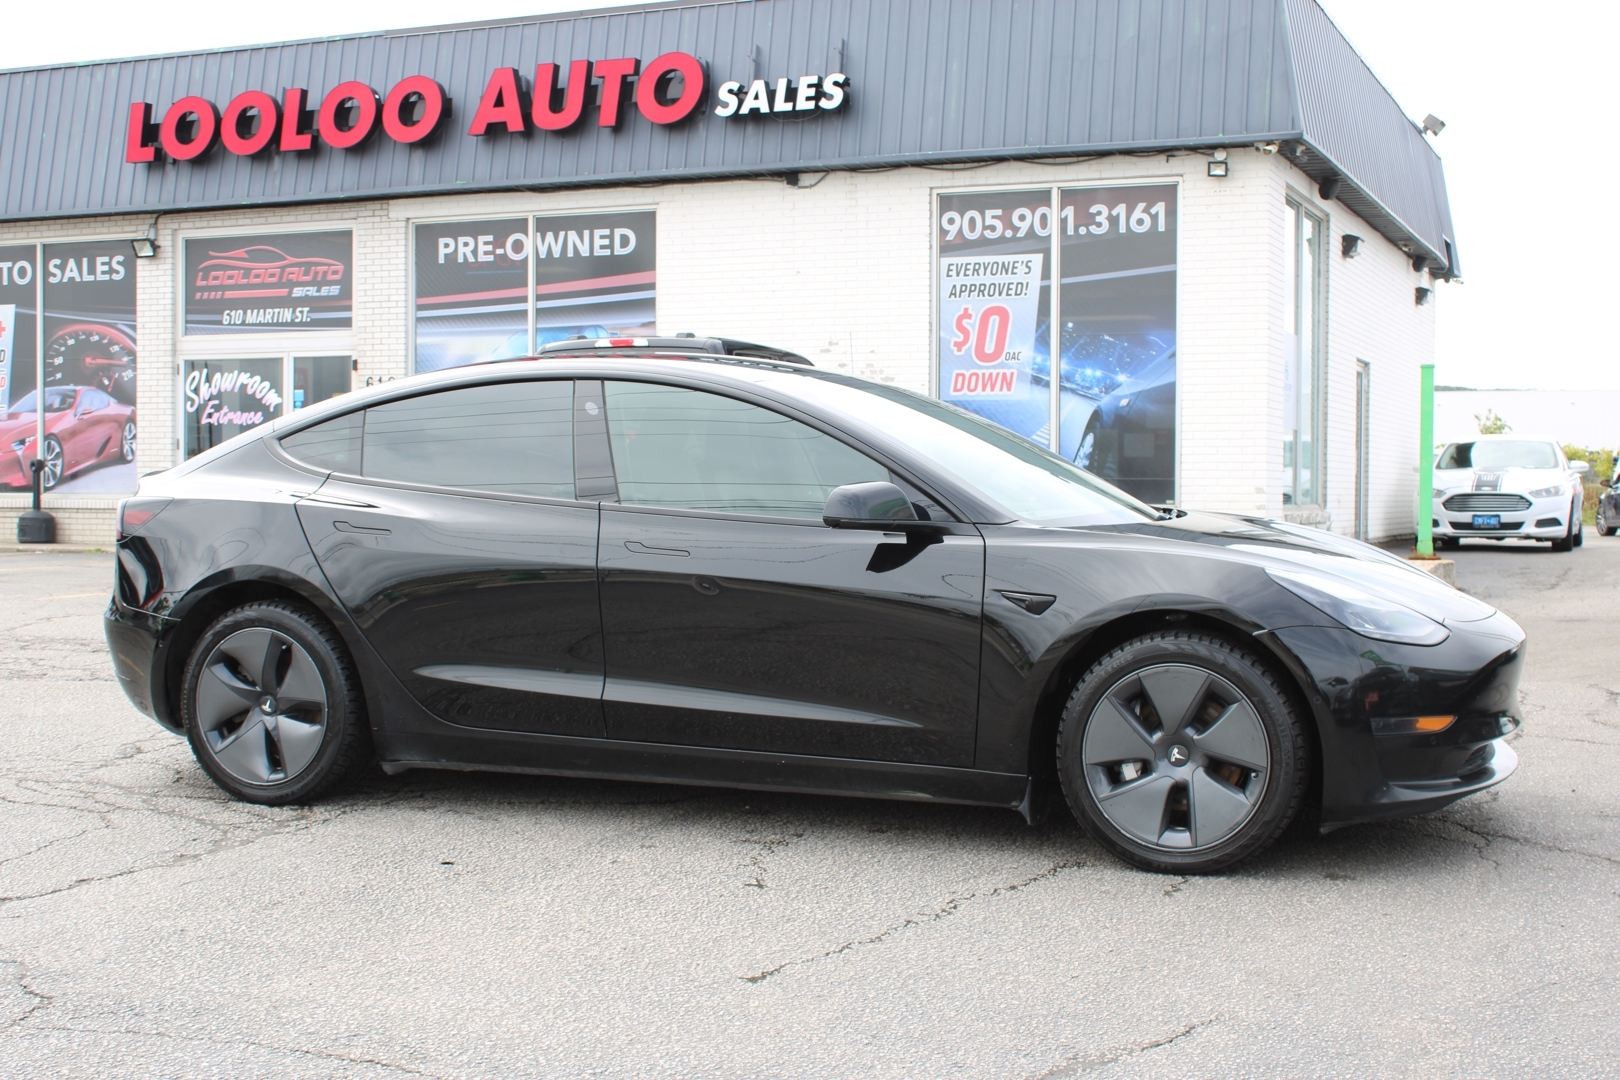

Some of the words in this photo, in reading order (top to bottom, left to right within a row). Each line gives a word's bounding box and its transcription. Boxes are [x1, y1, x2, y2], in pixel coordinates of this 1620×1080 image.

[126, 75, 444, 163] LOOLOO
[467, 51, 705, 136] AUTO
[714, 72, 849, 118] SALES
[941, 202, 1166, 241] 905.901.3161
[438, 227, 636, 264] PRE-OWNED
[48, 255, 126, 284] SALES
[195, 268, 281, 287] LOOLOO
[282, 265, 345, 283] AUTO
[945, 259, 1033, 278] EVERYONE'S
[291, 285, 342, 298] SALES
[948, 281, 1029, 299] APPROVED!
[222, 309, 243, 325] 610
[245, 307, 292, 324] MARTIN
[294, 307, 311, 323] ST.
[952, 305, 1011, 364] $0
[1004, 351, 1022, 362] OAC
[185, 368, 283, 413] Showroom
[952, 371, 1015, 393] DOWN
[200, 400, 264, 426] Entrance
